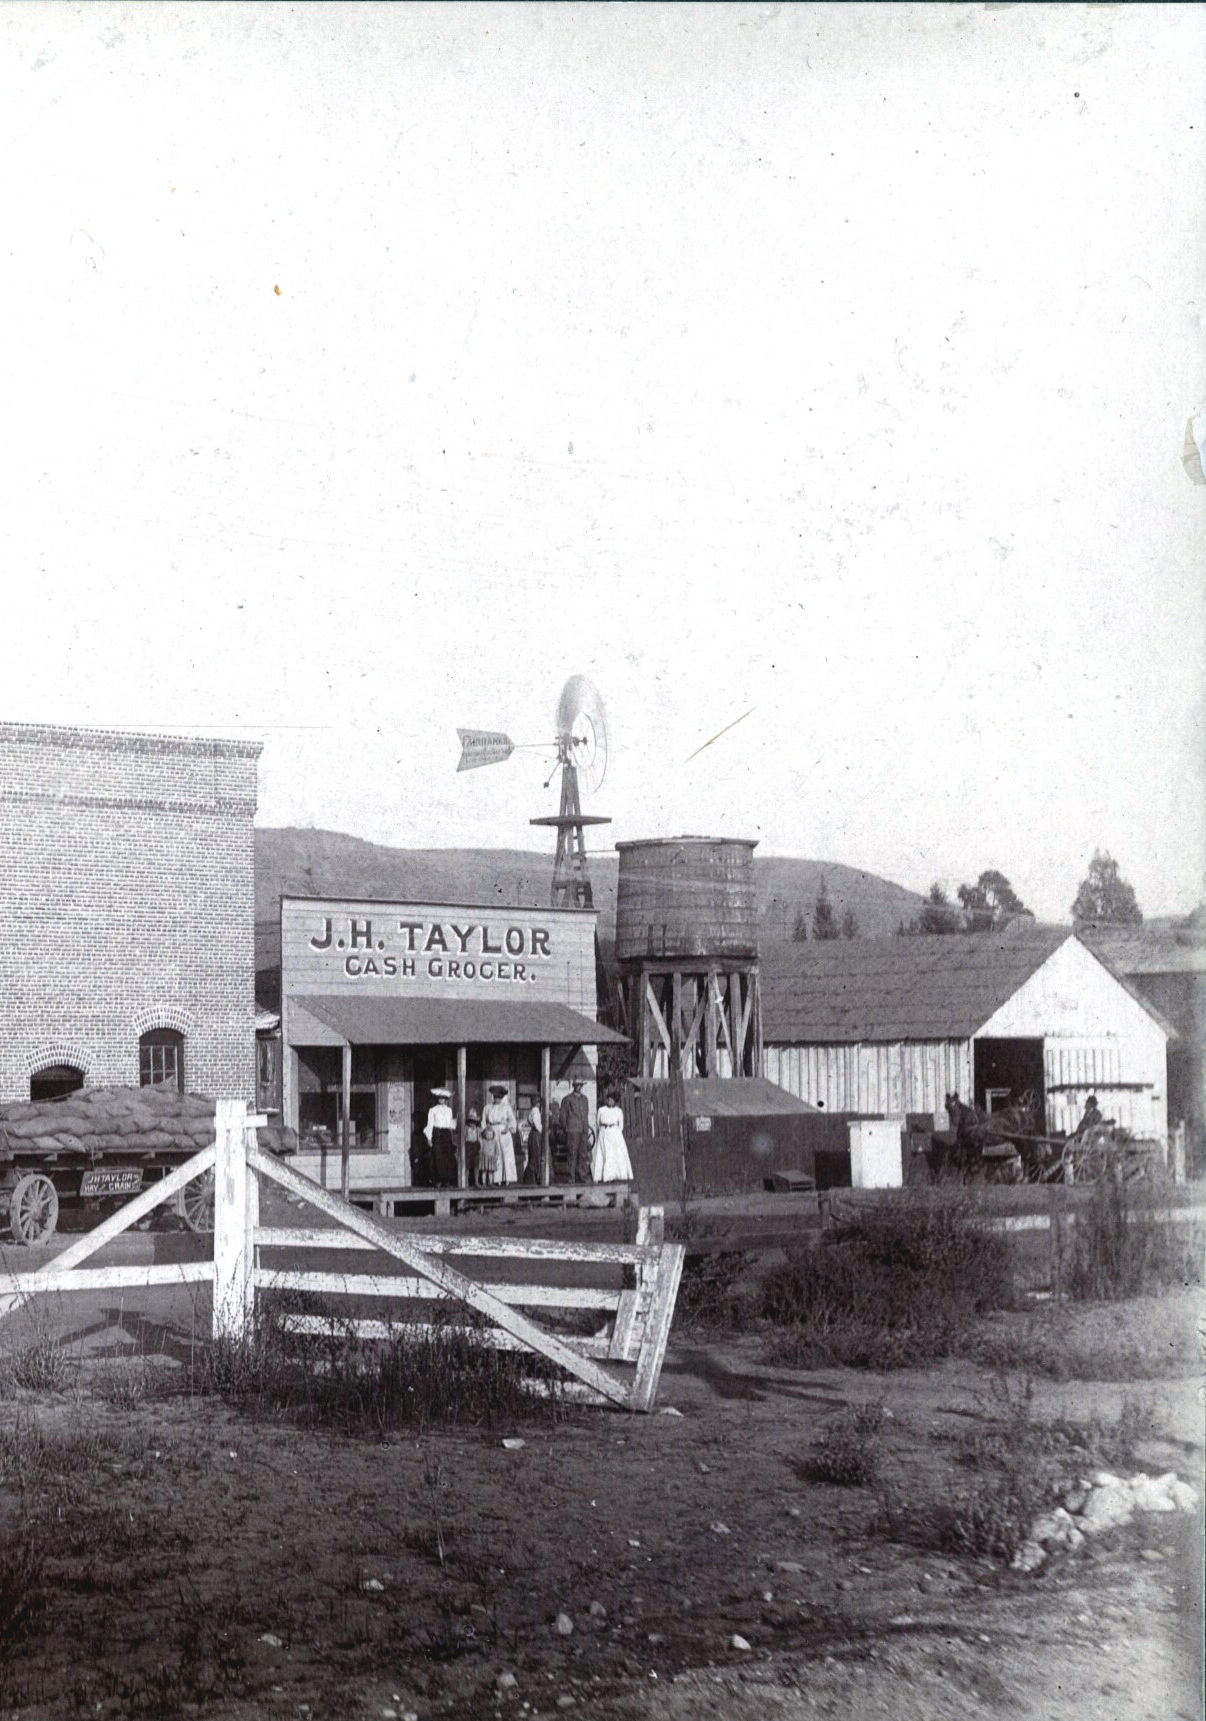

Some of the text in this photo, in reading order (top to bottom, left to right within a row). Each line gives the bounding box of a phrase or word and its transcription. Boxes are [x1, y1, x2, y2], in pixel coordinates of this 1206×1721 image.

[310, 918, 551, 957] J.H. TAYLOR
[345, 956, 536, 981] CASH GROCER.
[101, 1173, 133, 1183] TAYLOR
[84, 1184, 99, 1193] HAY
[108, 1182, 132, 1191] GRAIN
